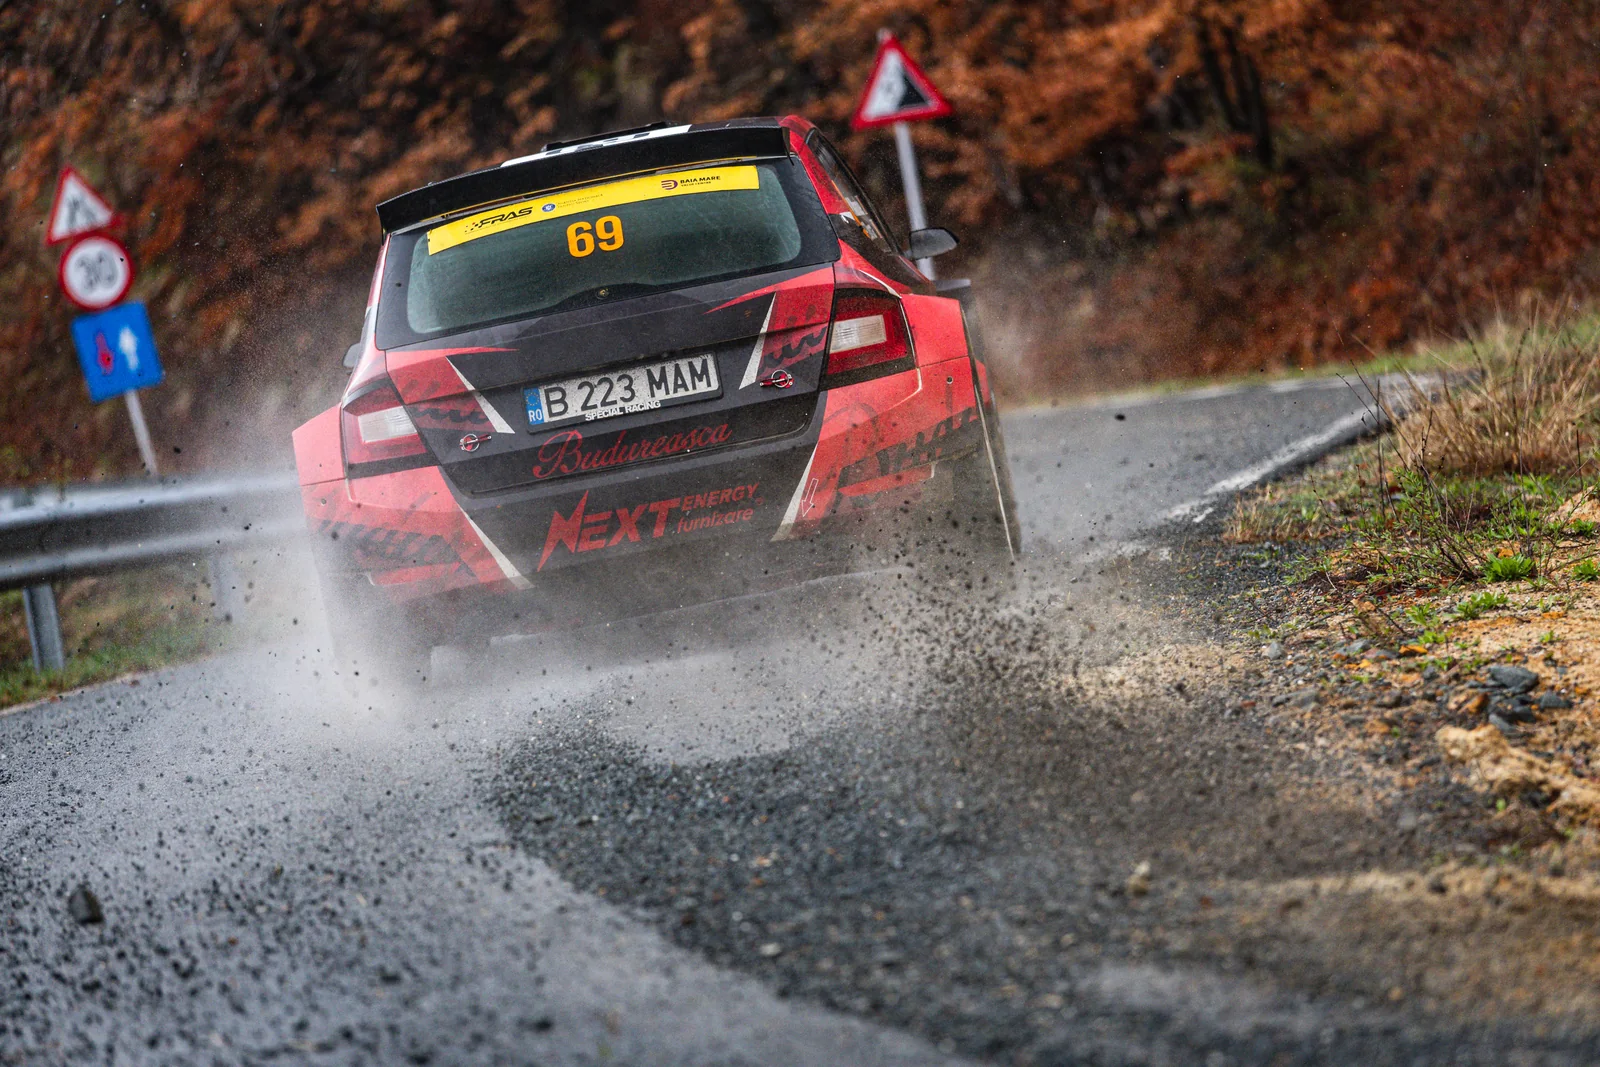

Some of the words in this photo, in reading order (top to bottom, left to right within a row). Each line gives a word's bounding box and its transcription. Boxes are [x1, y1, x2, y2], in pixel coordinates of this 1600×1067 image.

[478, 207, 533, 228] FRAS
[566, 215, 624, 258] 69
[544, 386, 569, 418] B
[577, 374, 636, 411] 223
[646, 359, 712, 398] MAM
[528, 408, 542, 422] RO
[585, 407, 623, 421] SPECIAL
[624, 400, 661, 413] RACING
[532, 423, 733, 479] Budureasca
[536, 489, 681, 573] NEXT
[681, 482, 759, 512] ENERGY
[677, 508, 754, 534] furnizare
